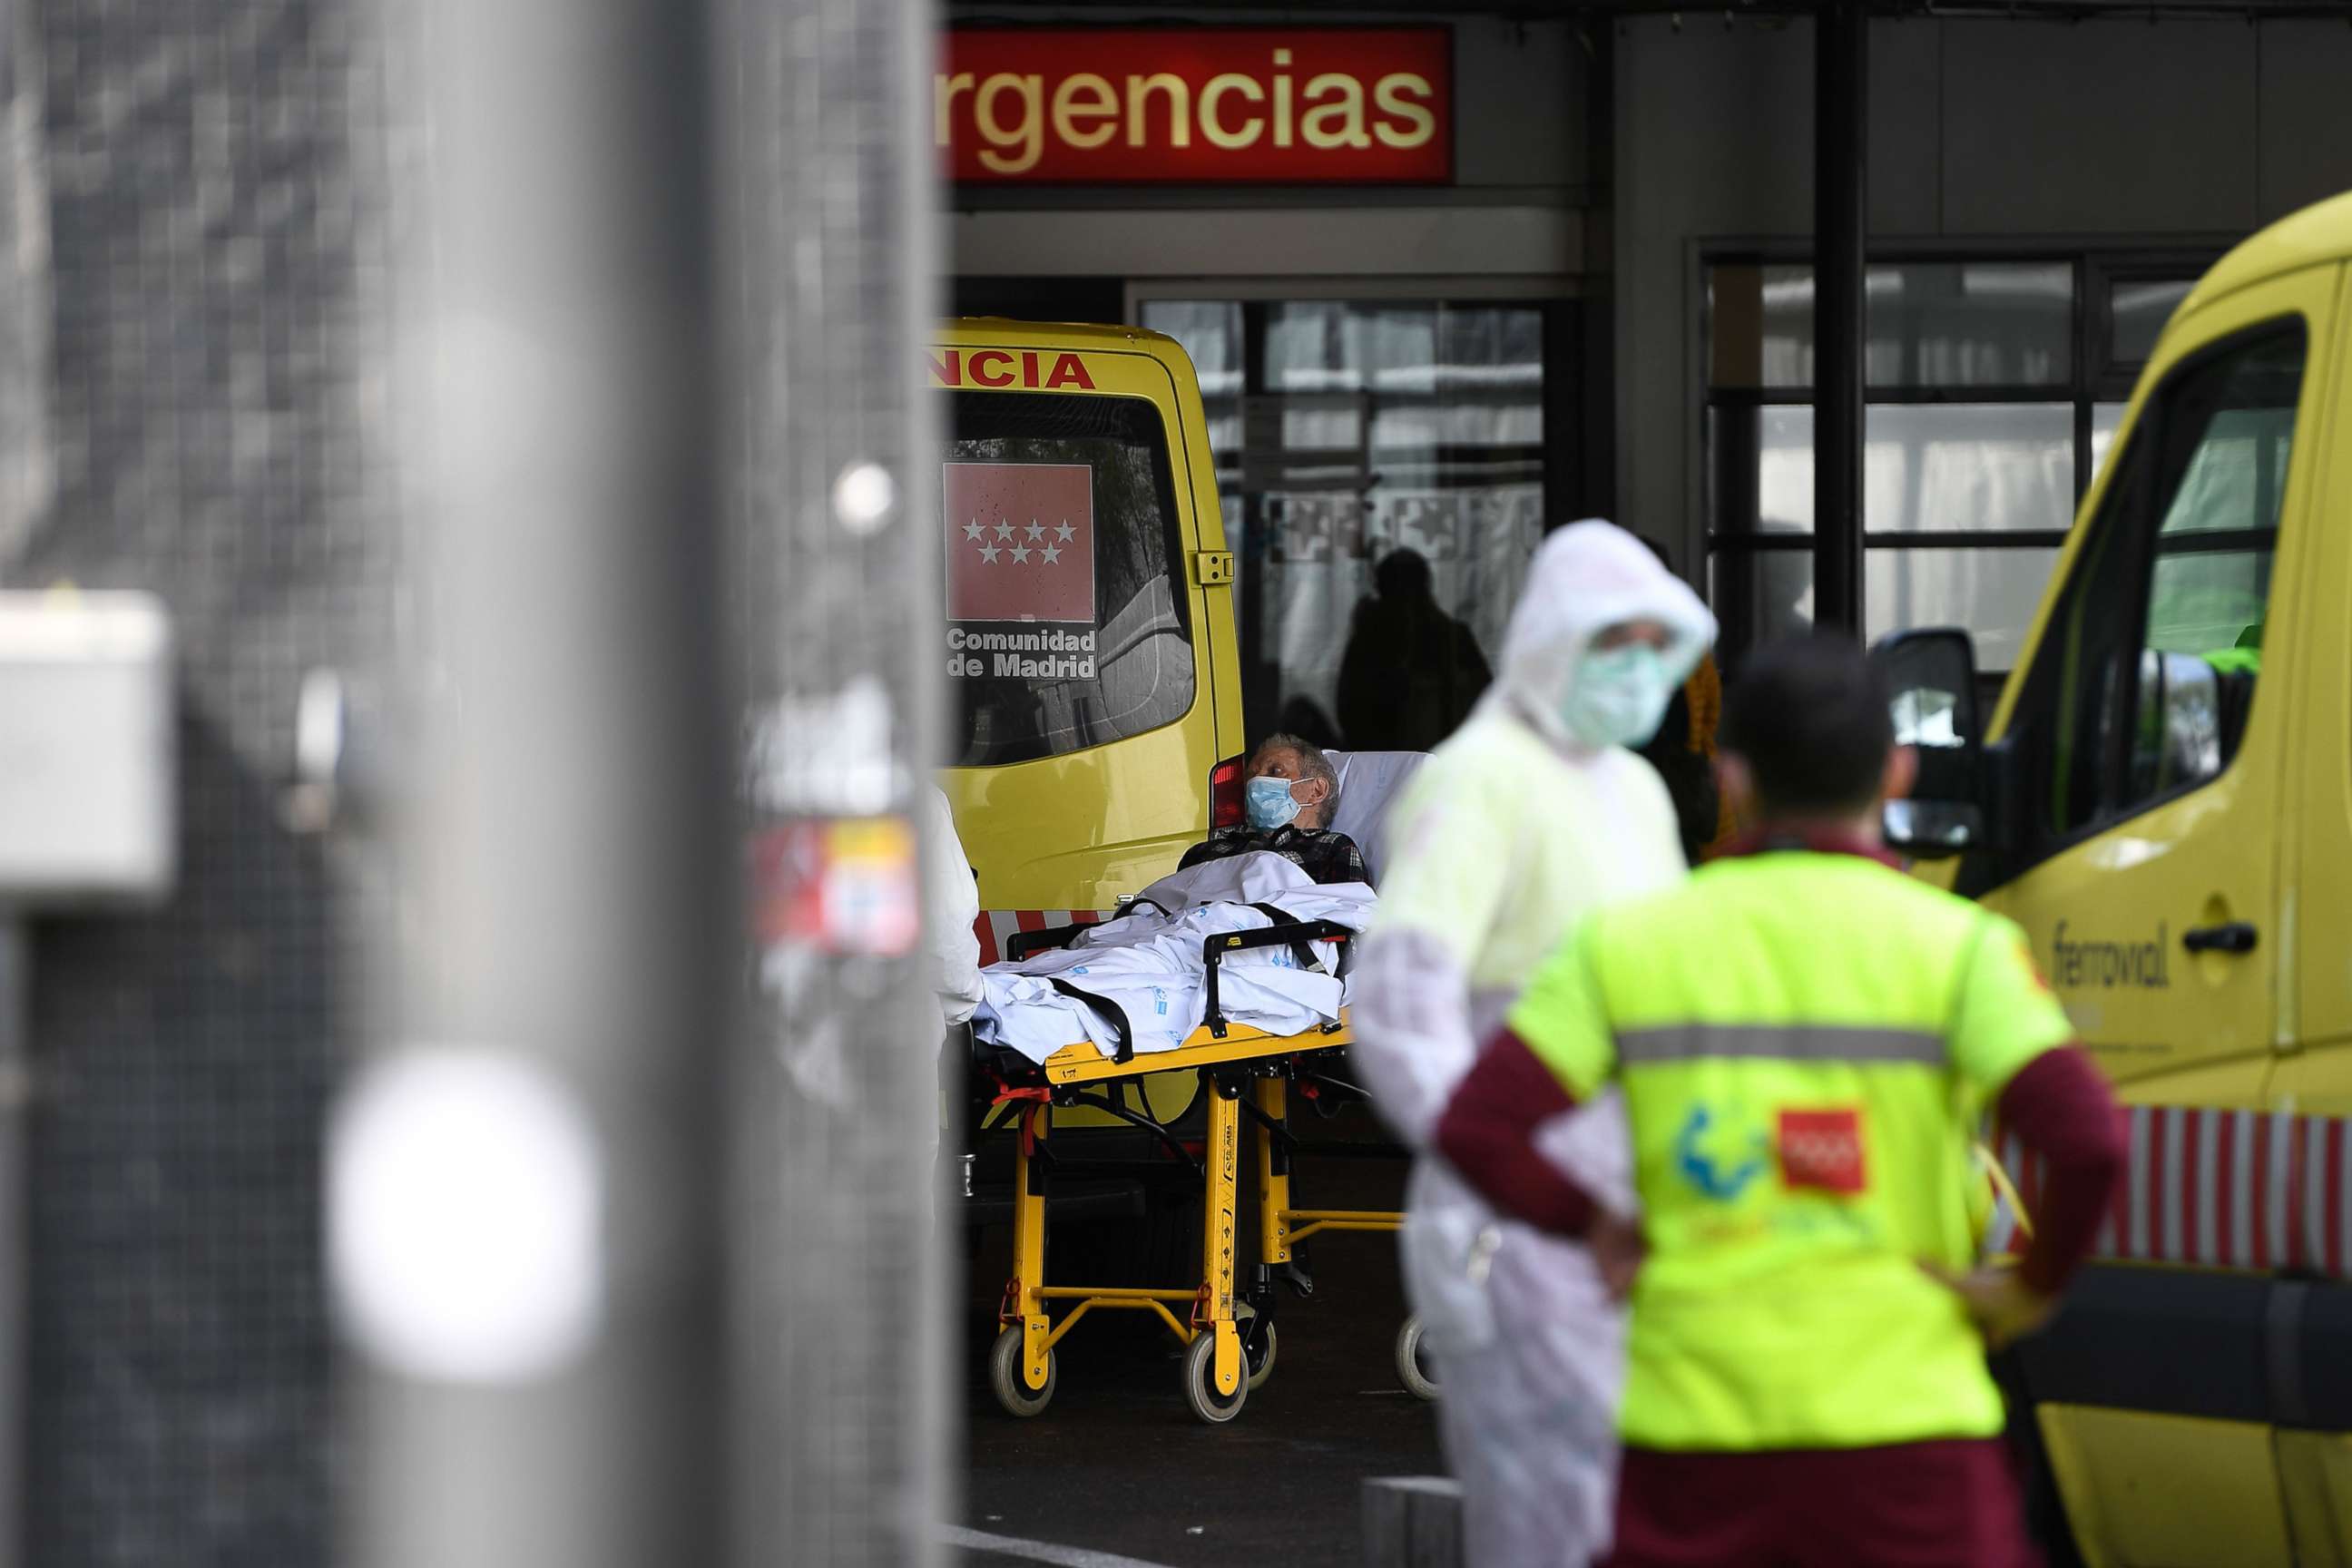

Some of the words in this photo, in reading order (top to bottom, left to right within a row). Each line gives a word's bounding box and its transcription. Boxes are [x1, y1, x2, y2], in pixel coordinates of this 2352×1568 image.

[934, 48, 1436, 173] rgencias
[925, 349, 1096, 390] NCIA
[946, 628, 1095, 652] Comunidad
[946, 653, 984, 677] de
[994, 653, 1095, 678] Madrid
